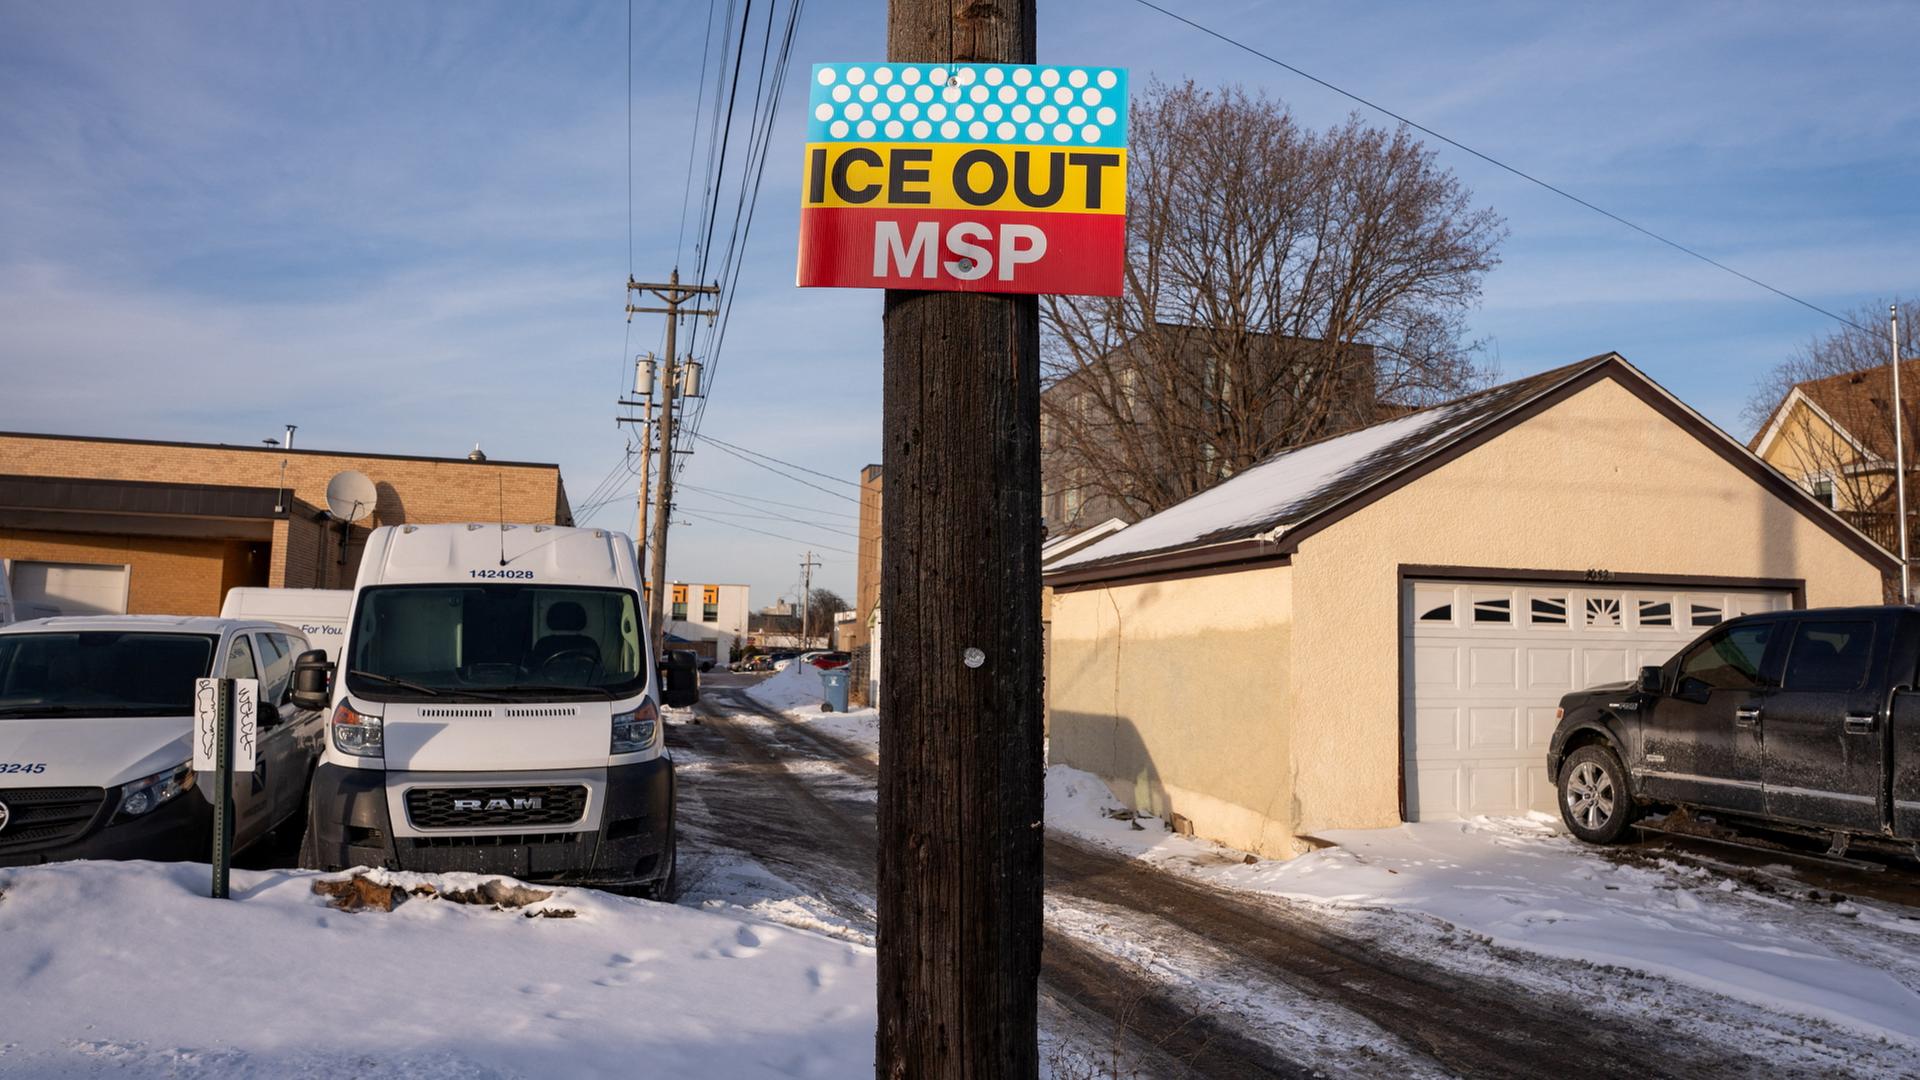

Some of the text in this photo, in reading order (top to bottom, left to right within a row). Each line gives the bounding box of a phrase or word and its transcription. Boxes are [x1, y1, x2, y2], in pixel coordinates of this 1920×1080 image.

[809, 147, 1120, 209] ICE OUT
[873, 220, 1047, 281] MSP
[469, 569, 534, 579] 1424028
[302, 624, 343, 636] For You.
[454, 797, 542, 811] RAM
